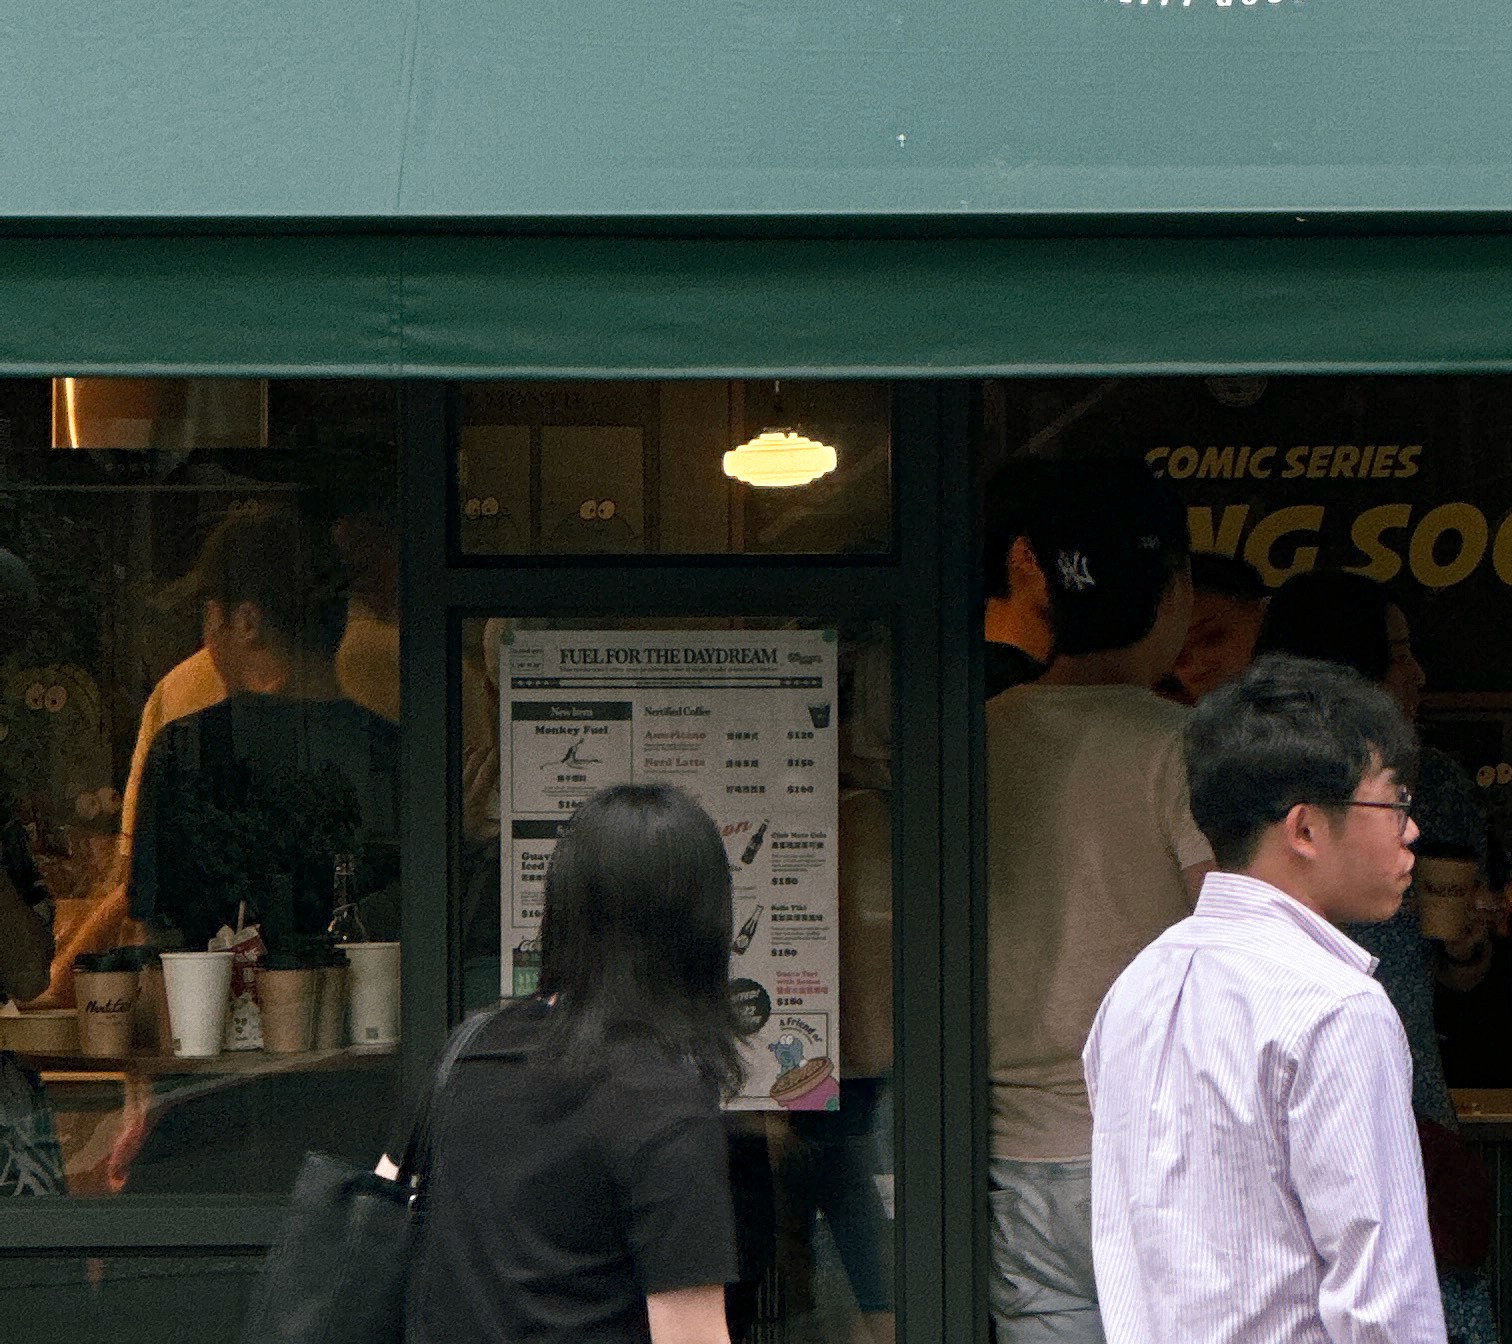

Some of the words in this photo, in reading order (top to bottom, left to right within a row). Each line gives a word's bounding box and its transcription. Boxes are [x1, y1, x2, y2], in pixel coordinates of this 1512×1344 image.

[1144, 445, 1277, 479] COMIC
[1281, 445, 1423, 479] SERIES
[560, 648, 603, 664] FUEL
[605, 648, 641, 664] FOR
[643, 648, 680, 664] THE
[683, 648, 778, 664] DAYDREAM
[535, 726, 580, 736] Monkey
[583, 726, 608, 734] Fuel
